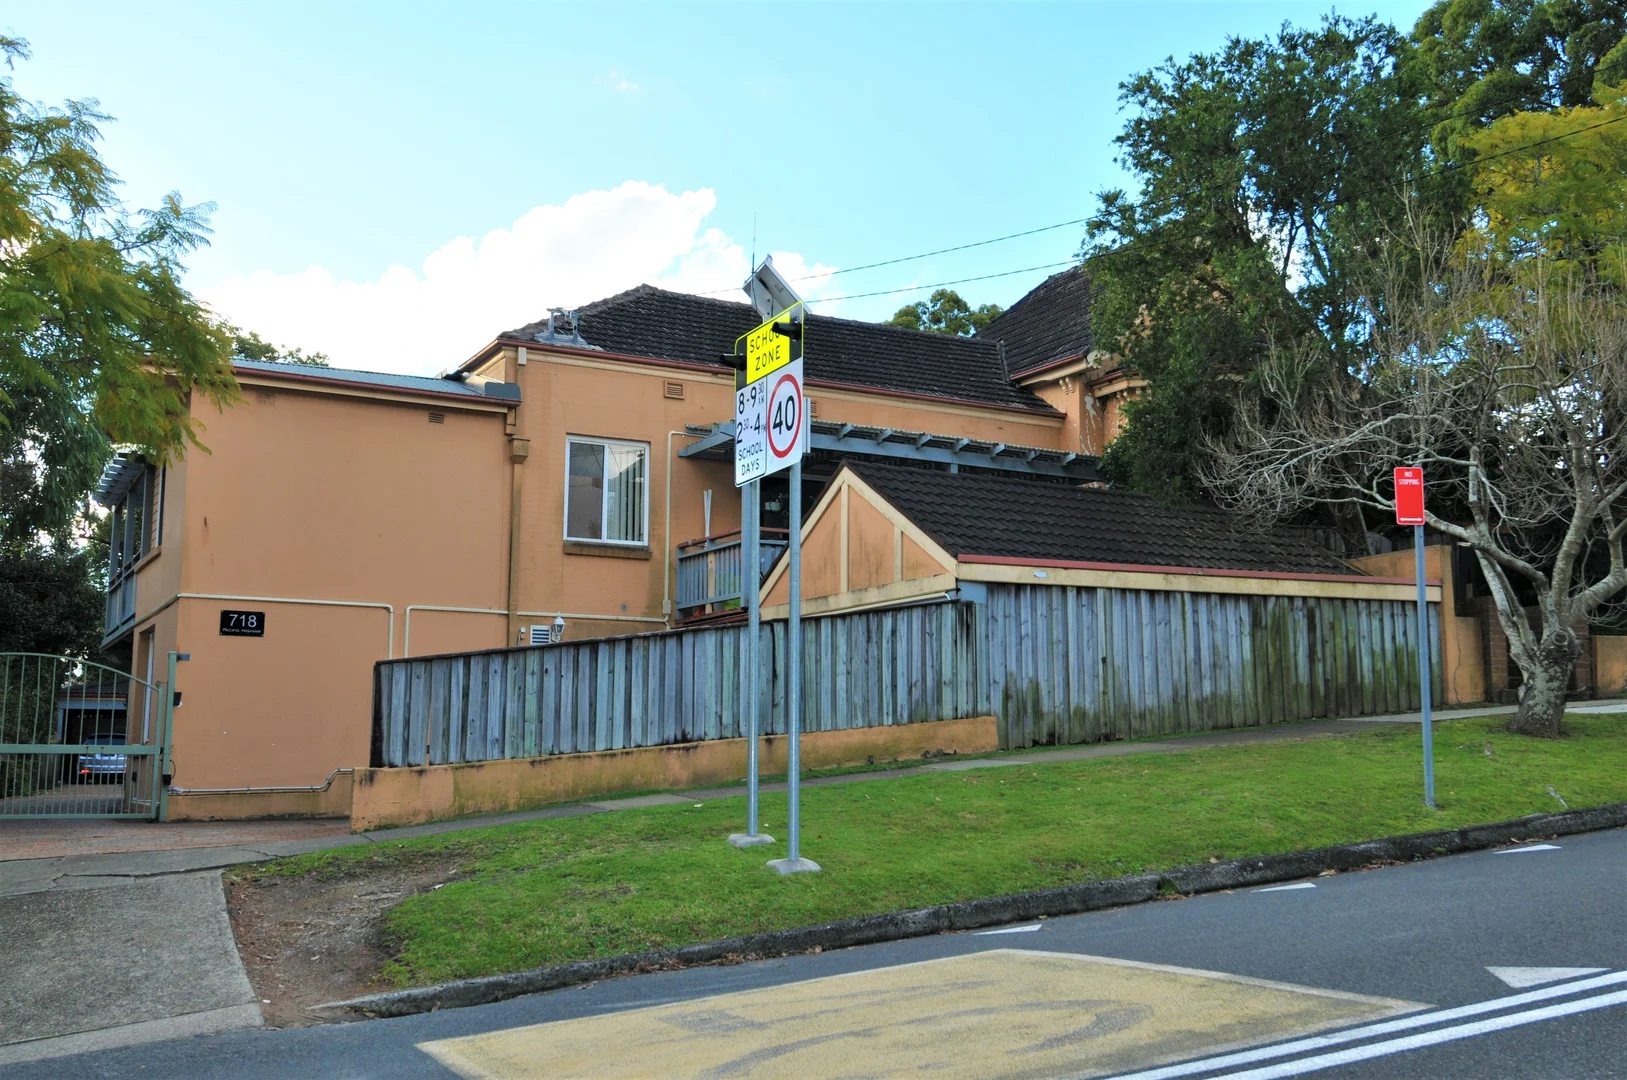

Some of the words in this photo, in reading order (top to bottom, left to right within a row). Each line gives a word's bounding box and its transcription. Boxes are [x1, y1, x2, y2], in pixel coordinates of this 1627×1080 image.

[750, 328, 780, 353] SCHO
[755, 344, 781, 371] ZONE
[772, 394, 796, 435] 40
[738, 440, 764, 462] SCHOOL
[741, 457, 760, 476] DAYS
[229, 613, 257, 628] 718
